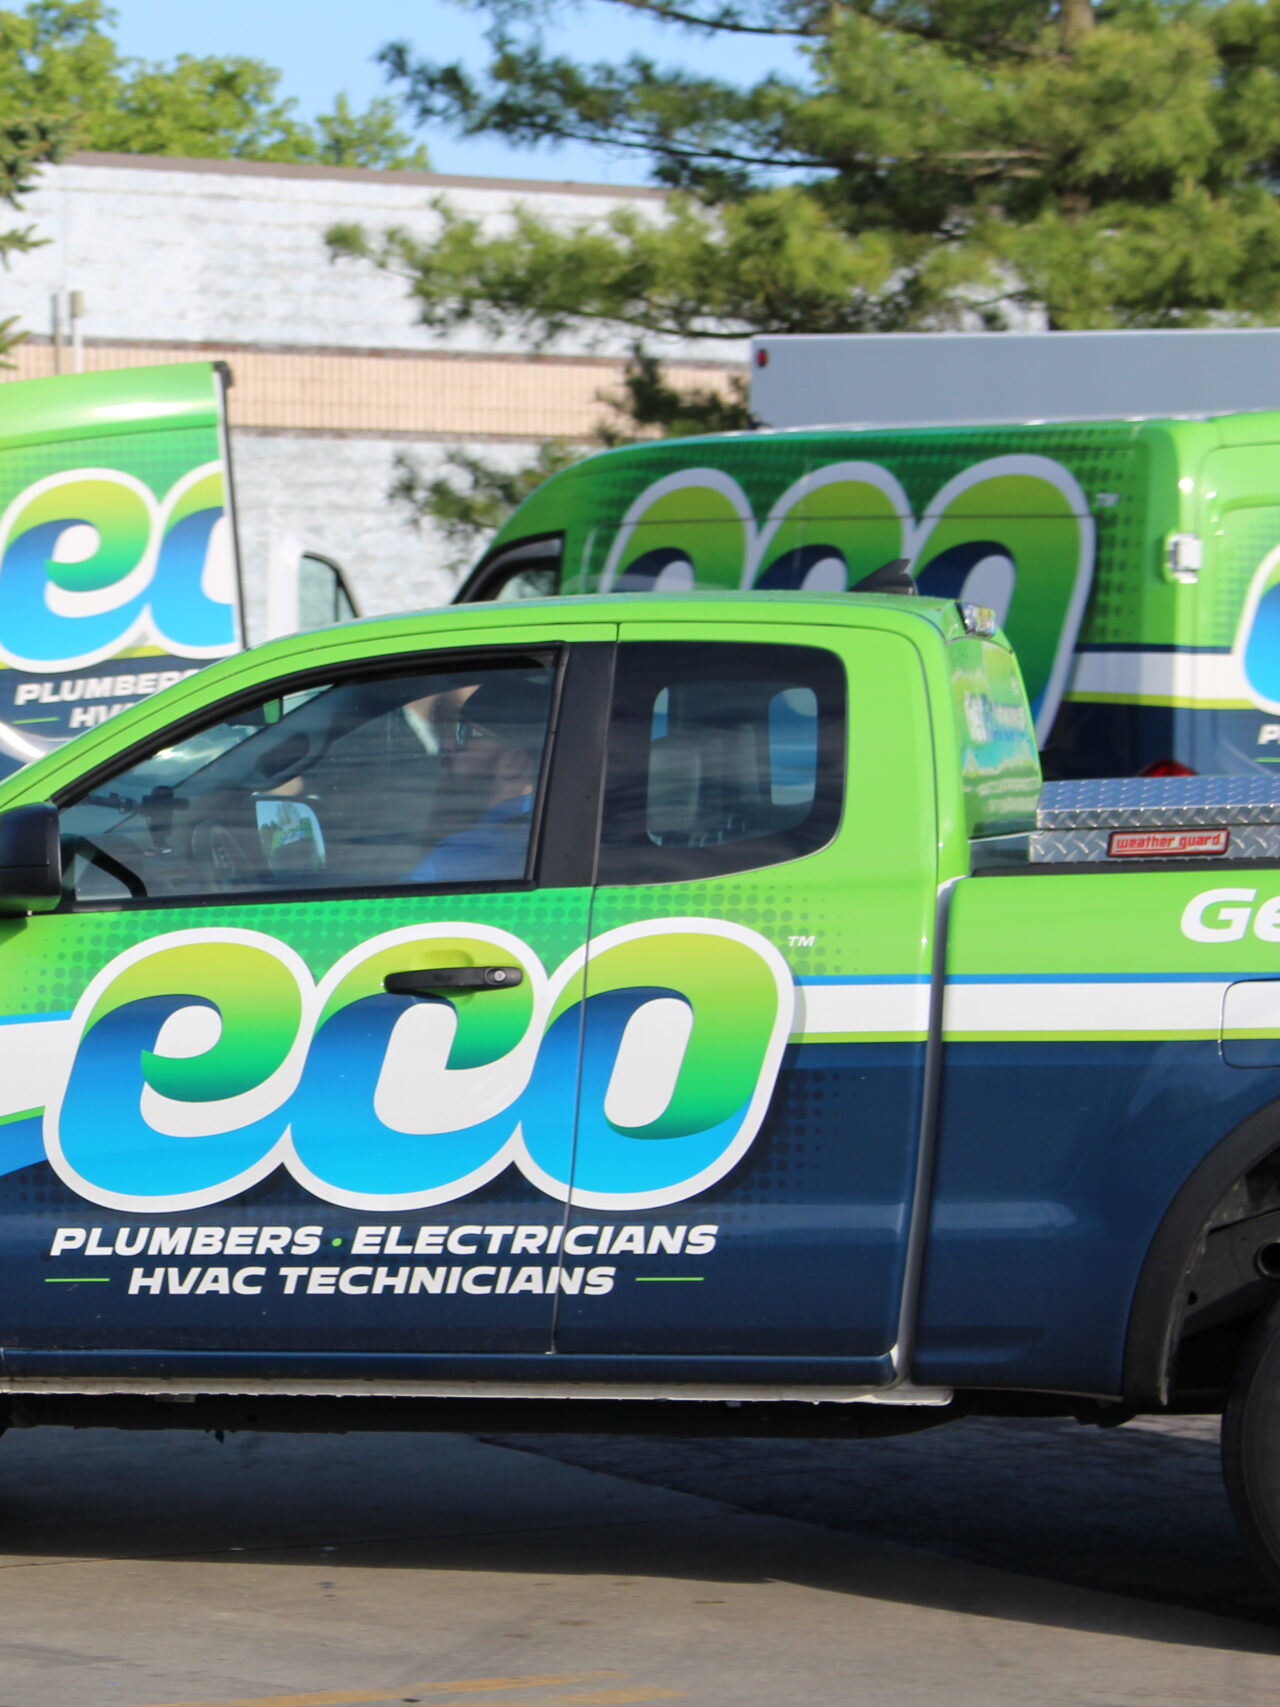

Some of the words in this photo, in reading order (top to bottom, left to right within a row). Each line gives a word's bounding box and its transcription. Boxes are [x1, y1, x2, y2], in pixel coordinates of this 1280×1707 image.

[43, 917, 798, 1213] eco
[50, 1226, 323, 1256] PLUMBERS
[351, 1224, 719, 1255] ELECTRICIANS
[128, 1266, 266, 1295] HVAC
[279, 1266, 616, 1295] TECHNICIANS
